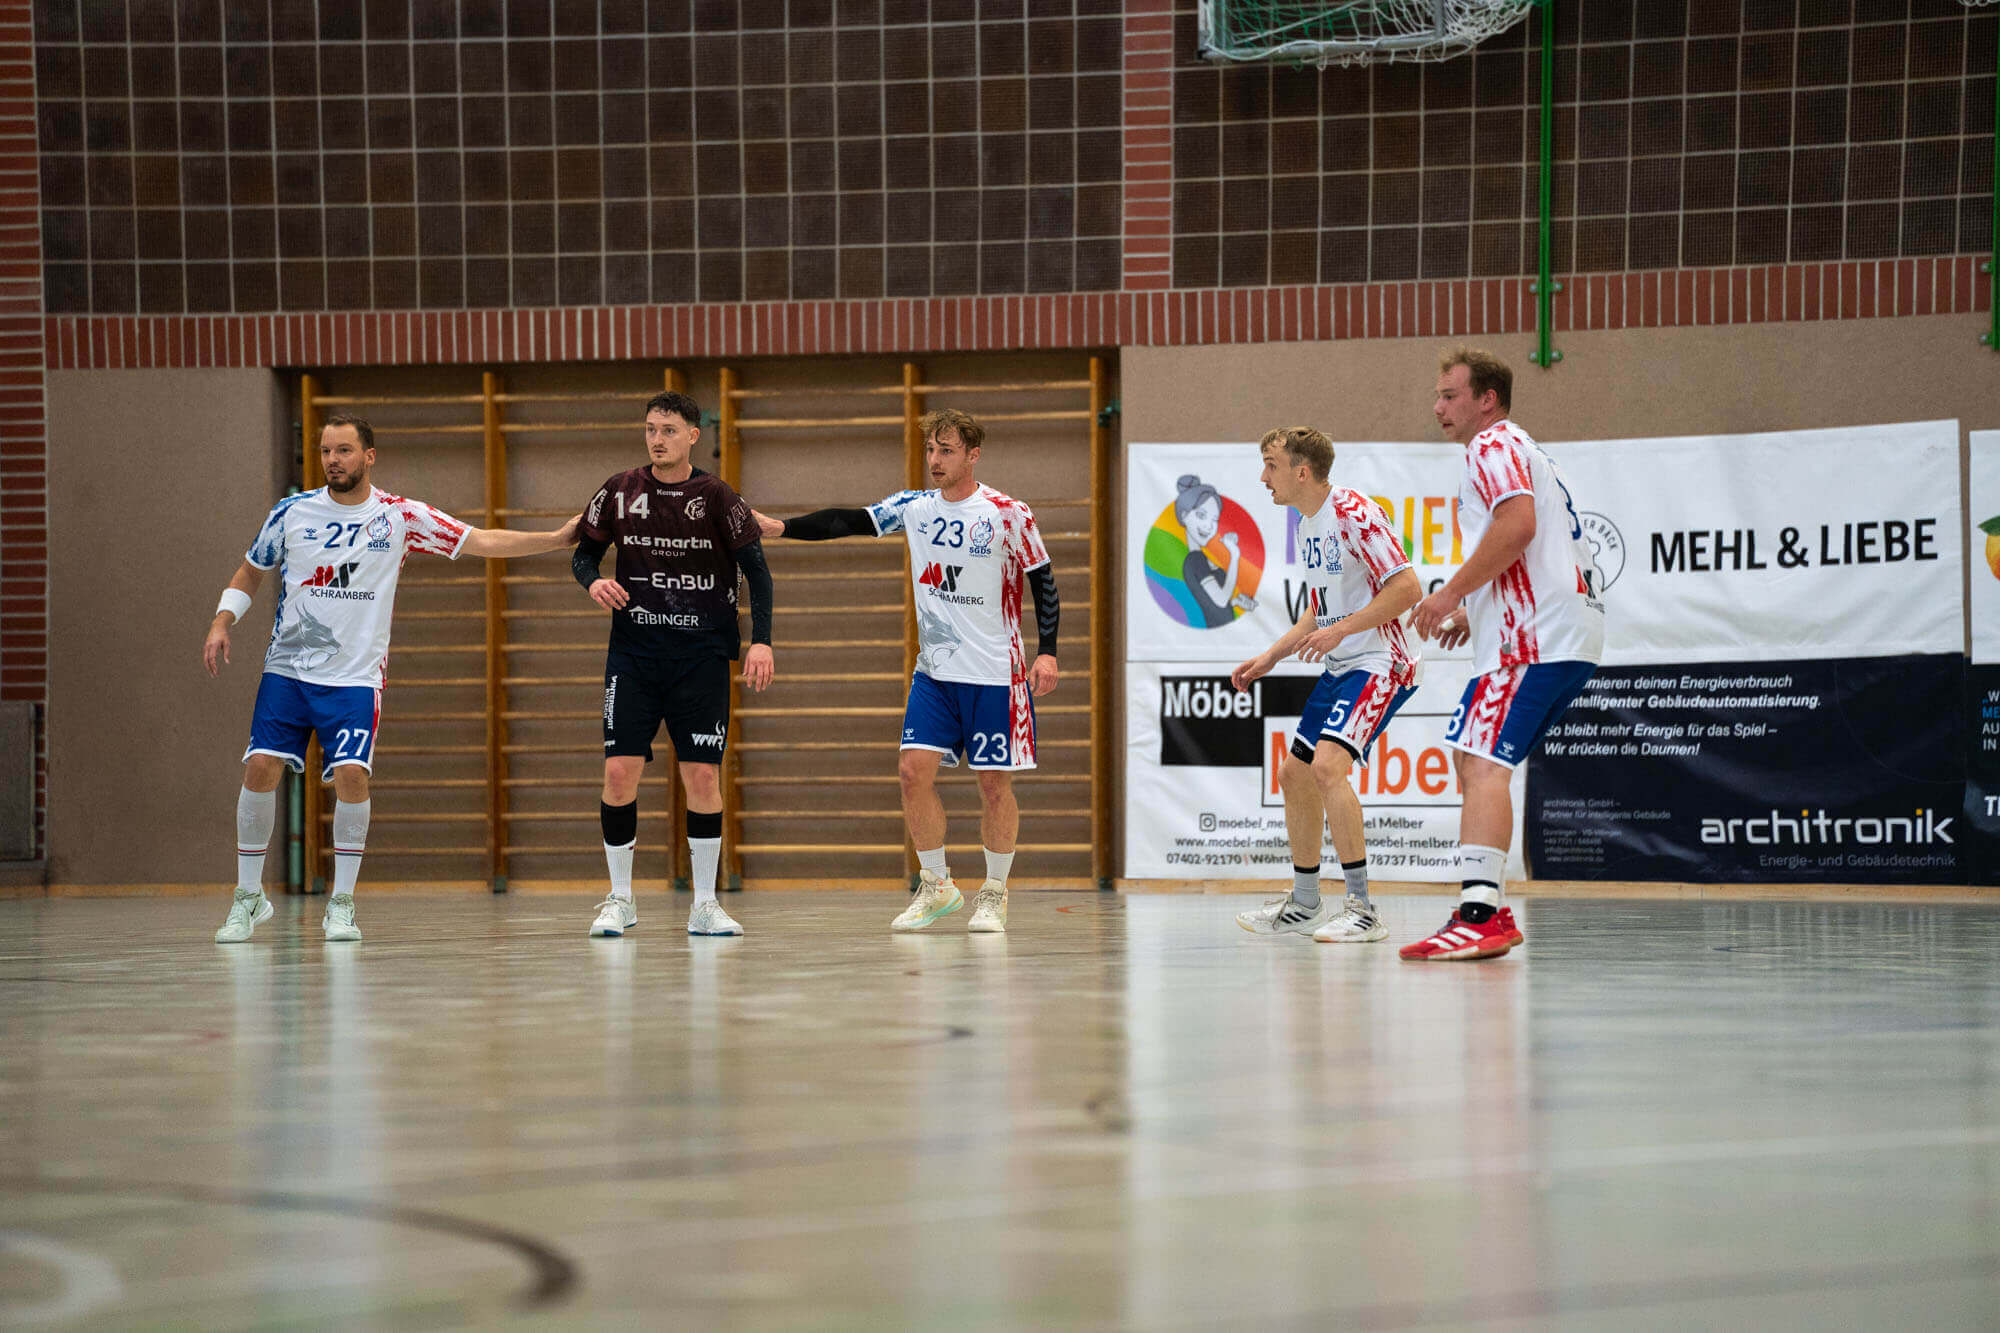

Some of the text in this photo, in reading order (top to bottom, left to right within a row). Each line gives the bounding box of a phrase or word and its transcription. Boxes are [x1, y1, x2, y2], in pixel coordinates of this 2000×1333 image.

[615, 491, 650, 519] 14
[324, 522, 363, 549] 27
[931, 517, 965, 548] 23
[367, 541, 391, 549] SGDS
[623, 535, 713, 550] KLS martin
[969, 546, 992, 555] SGDS
[1651, 518, 1938, 573] MEHL & LIEBE
[650, 549, 686, 557] GROUP
[1306, 537, 1322, 569] 25
[652, 572, 714, 591] EnBW
[310, 588, 375, 600] SCHRAMBERG
[928, 587, 984, 605] SCHRAMBERG
[1634, 676, 1676, 690] deinen
[1680, 674, 1793, 691] Energieverbrauch
[1164, 681, 1262, 718] Möbel
[1568, 693, 1821, 711] ntelligenter Gebäudeautomatisierung.
[1324, 699, 1350, 727] 5
[1545, 725, 1561, 737] So
[1564, 723, 1598, 737] bleibt
[1600, 723, 1630, 737] mehr
[1633, 723, 1684, 740] Energie
[1688, 723, 1706, 737] für
[1707, 723, 1730, 737] das
[1734, 722, 1766, 739] Spiel
[335, 728, 370, 758] 27
[972, 732, 1008, 762] 23
[1545, 741, 1701, 756] Wir drücken die Daumen!
[1983, 738, 1997, 750] IN
[1984, 795, 2000, 816] T
[1379, 817, 1425, 829] Melber
[1701, 808, 1955, 844] architronik
[1166, 853, 1242, 865] 07402-92170
[1370, 854, 1406, 866] 78737
[1759, 853, 1956, 868] Energie- und Gebäudetechnik
